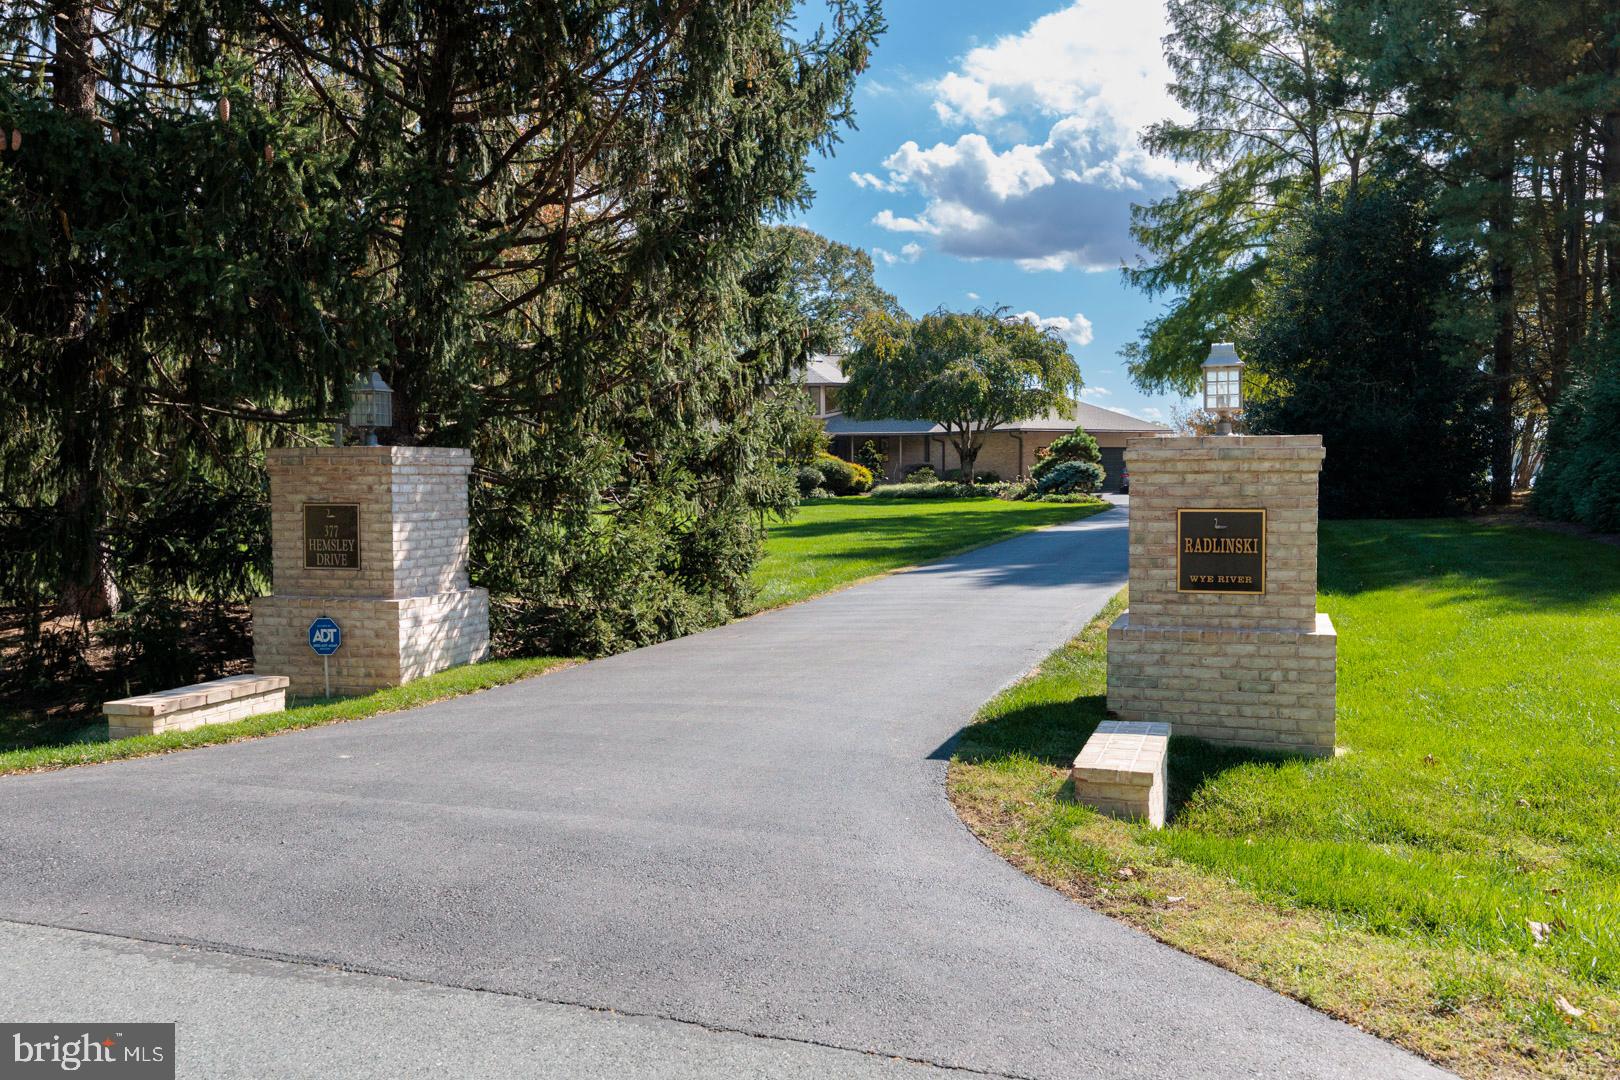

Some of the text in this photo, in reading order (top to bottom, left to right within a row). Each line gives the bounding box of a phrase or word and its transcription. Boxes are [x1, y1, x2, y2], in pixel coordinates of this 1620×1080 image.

[324, 525, 339, 538] 377
[308, 538, 355, 552] HEMSLEY
[1184, 537, 1258, 554] RADLINSKI
[316, 553, 348, 566] DRIVE
[1190, 575, 1252, 584] WYE RIVER
[312, 628, 337, 643] ADT
